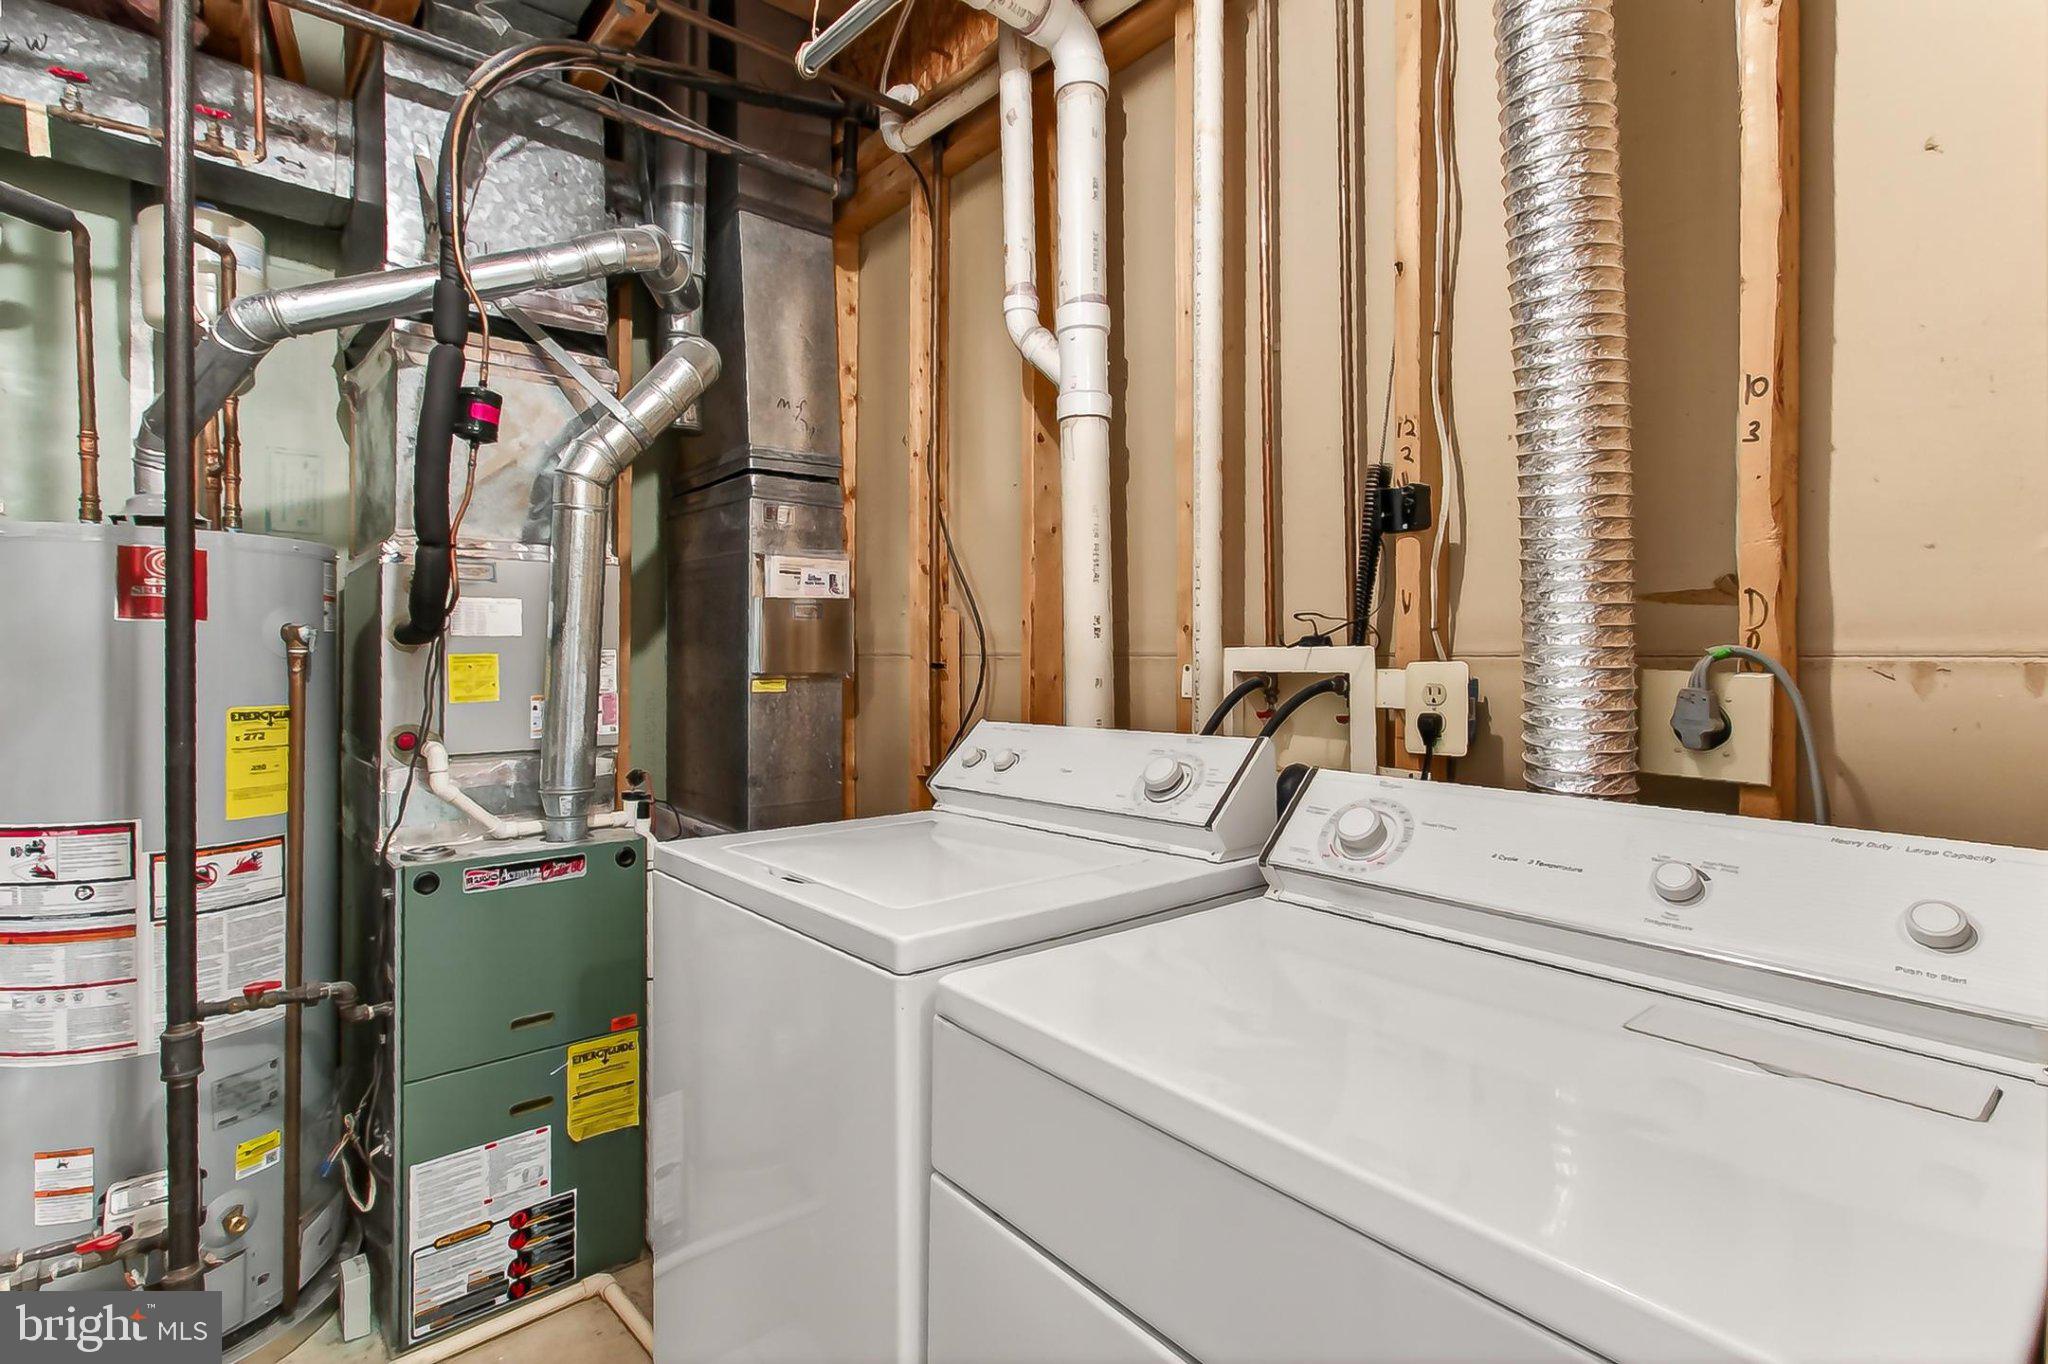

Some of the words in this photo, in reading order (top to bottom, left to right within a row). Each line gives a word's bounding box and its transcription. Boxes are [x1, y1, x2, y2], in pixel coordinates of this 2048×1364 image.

[1744, 373, 1769, 405] 10
[1397, 415, 1416, 438] 12
[1742, 420, 1761, 443] 3
[1400, 446, 1415, 463] 2
[1831, 836, 1864, 849] Heavy
[1866, 841, 1893, 851] Duty
[1905, 845, 1940, 856] Large
[1943, 850, 1997, 864] Capacity
[1895, 965, 1923, 976] Push
[1926, 971, 1938, 979] to
[1940, 974, 1967, 985] Start
